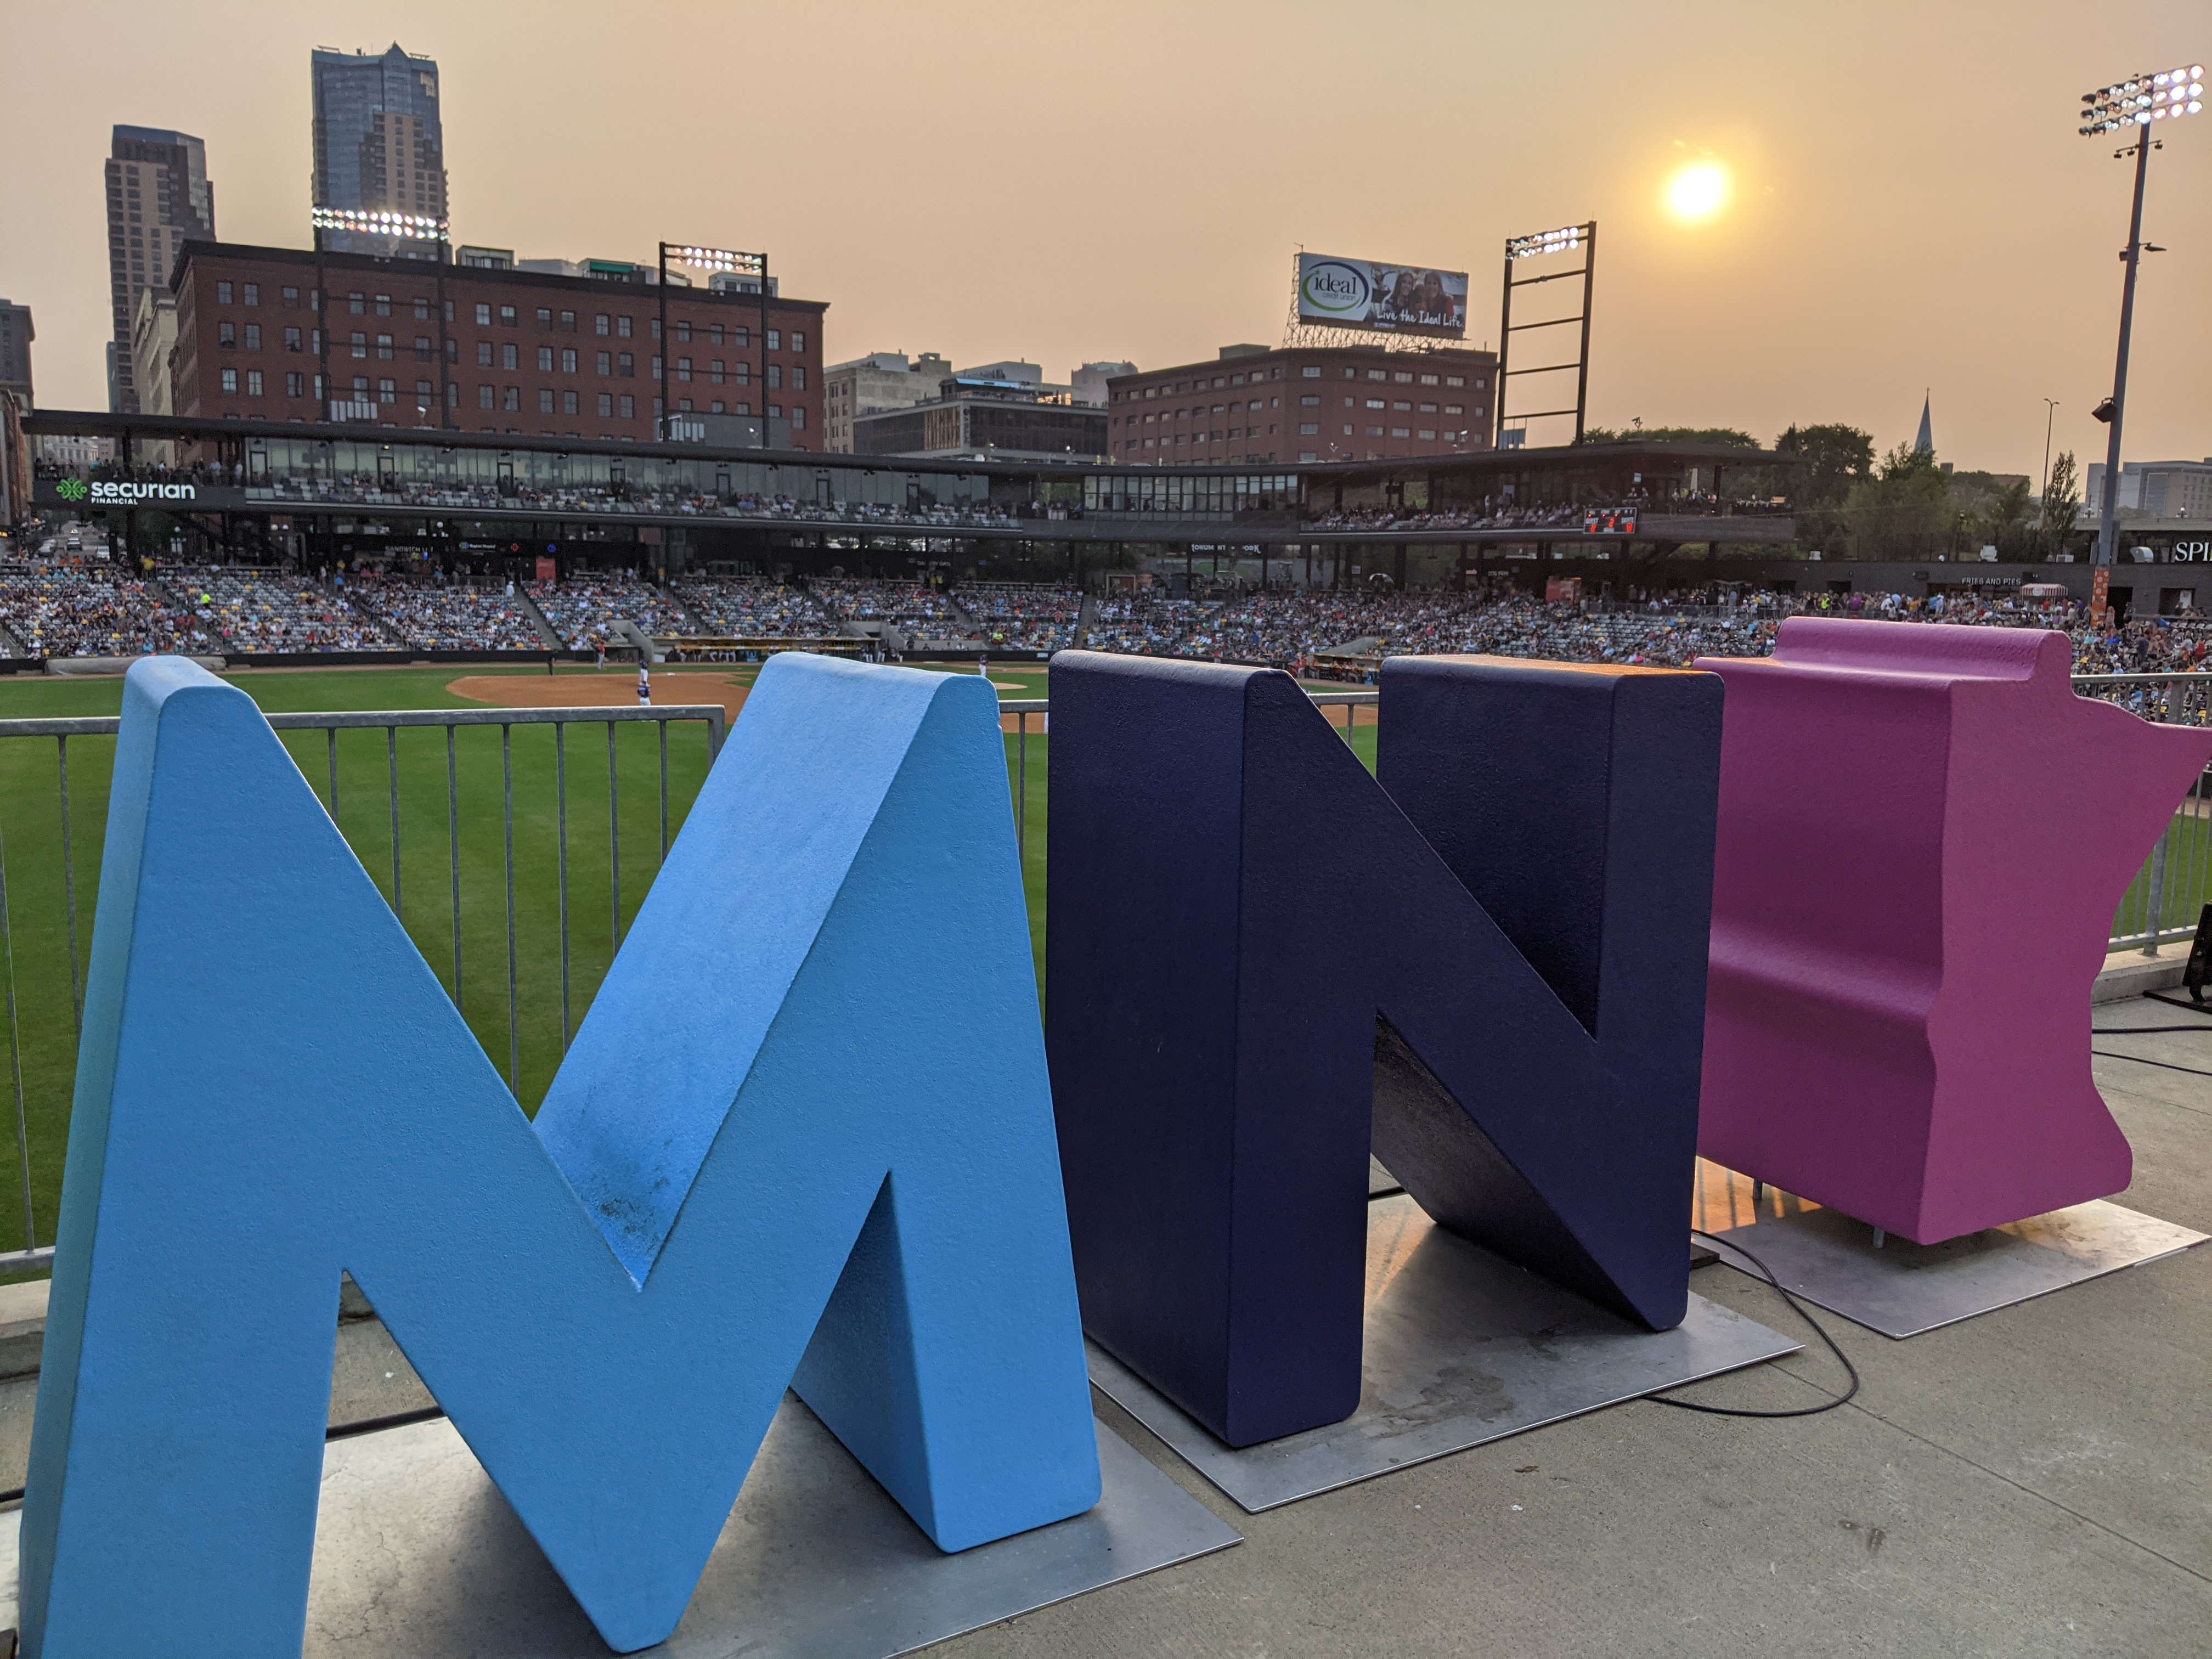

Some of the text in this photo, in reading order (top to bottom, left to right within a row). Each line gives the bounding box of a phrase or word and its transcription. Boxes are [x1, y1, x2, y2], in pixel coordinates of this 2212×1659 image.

[1314, 273, 1357, 295] ideal
[1377, 309, 1397, 321] Live
[1400, 309, 1416, 323] the
[1419, 310, 1441, 325] Ideal
[91, 481, 195, 500] securian
[91, 497, 138, 505] FINANCIAL
[2175, 541, 2212, 561] SPI
[1986, 577, 2001, 585] AND
[2004, 577, 2021, 585] PIES
